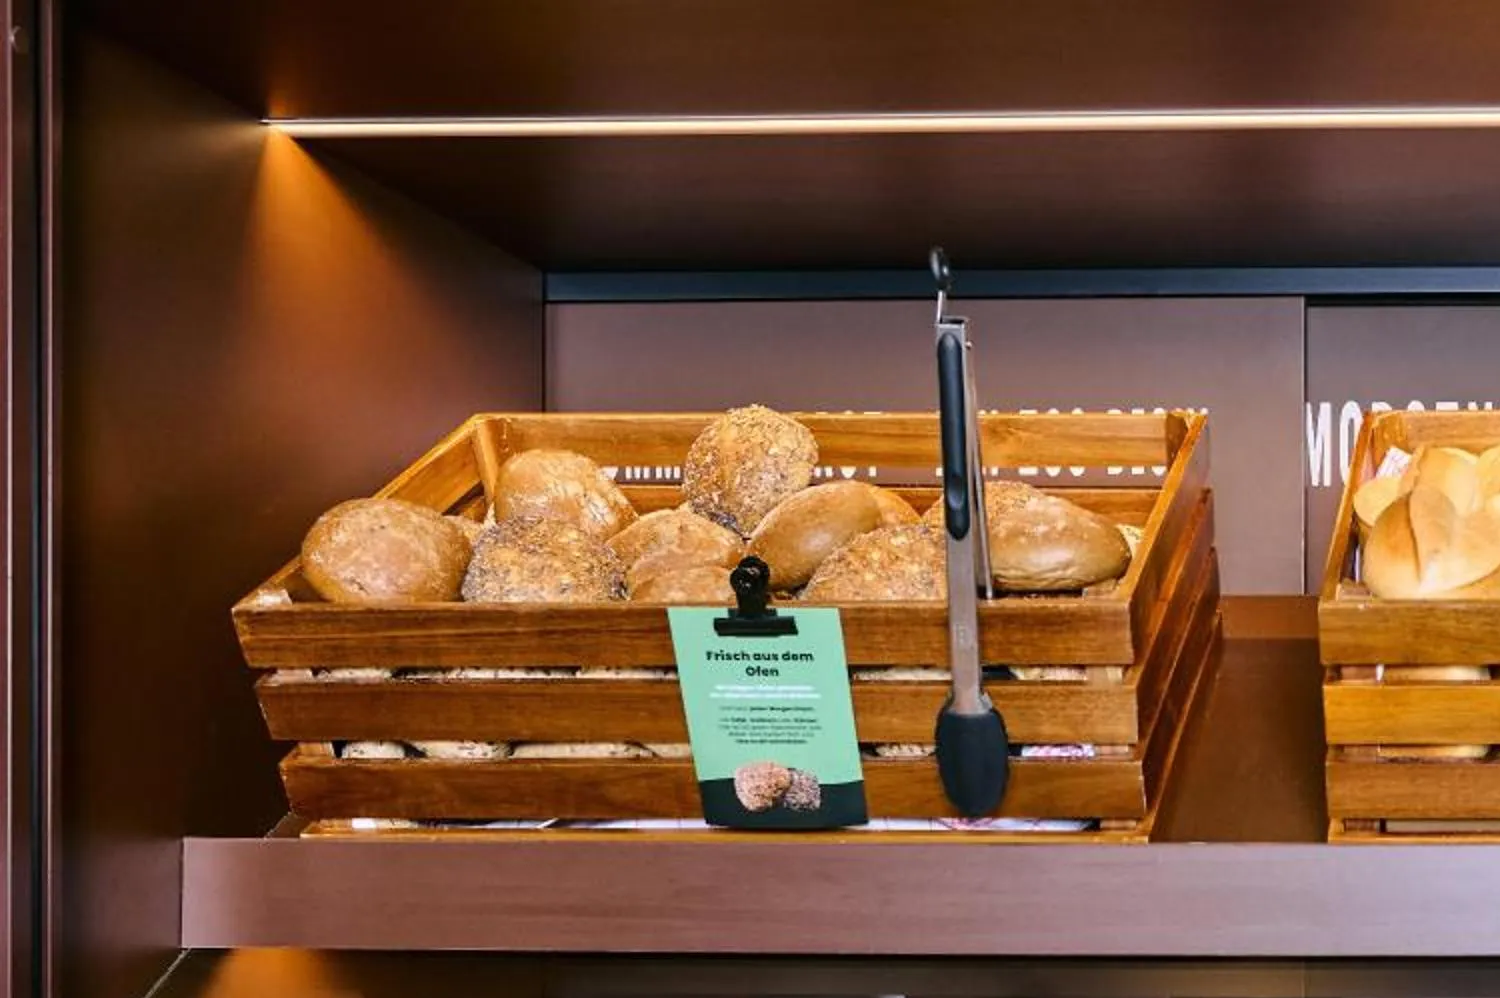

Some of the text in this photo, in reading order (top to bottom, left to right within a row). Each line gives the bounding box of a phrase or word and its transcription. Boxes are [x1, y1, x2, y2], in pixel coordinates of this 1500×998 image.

[705, 650, 814, 662] Frisch aus dem
[745, 666, 780, 677] Ofen
